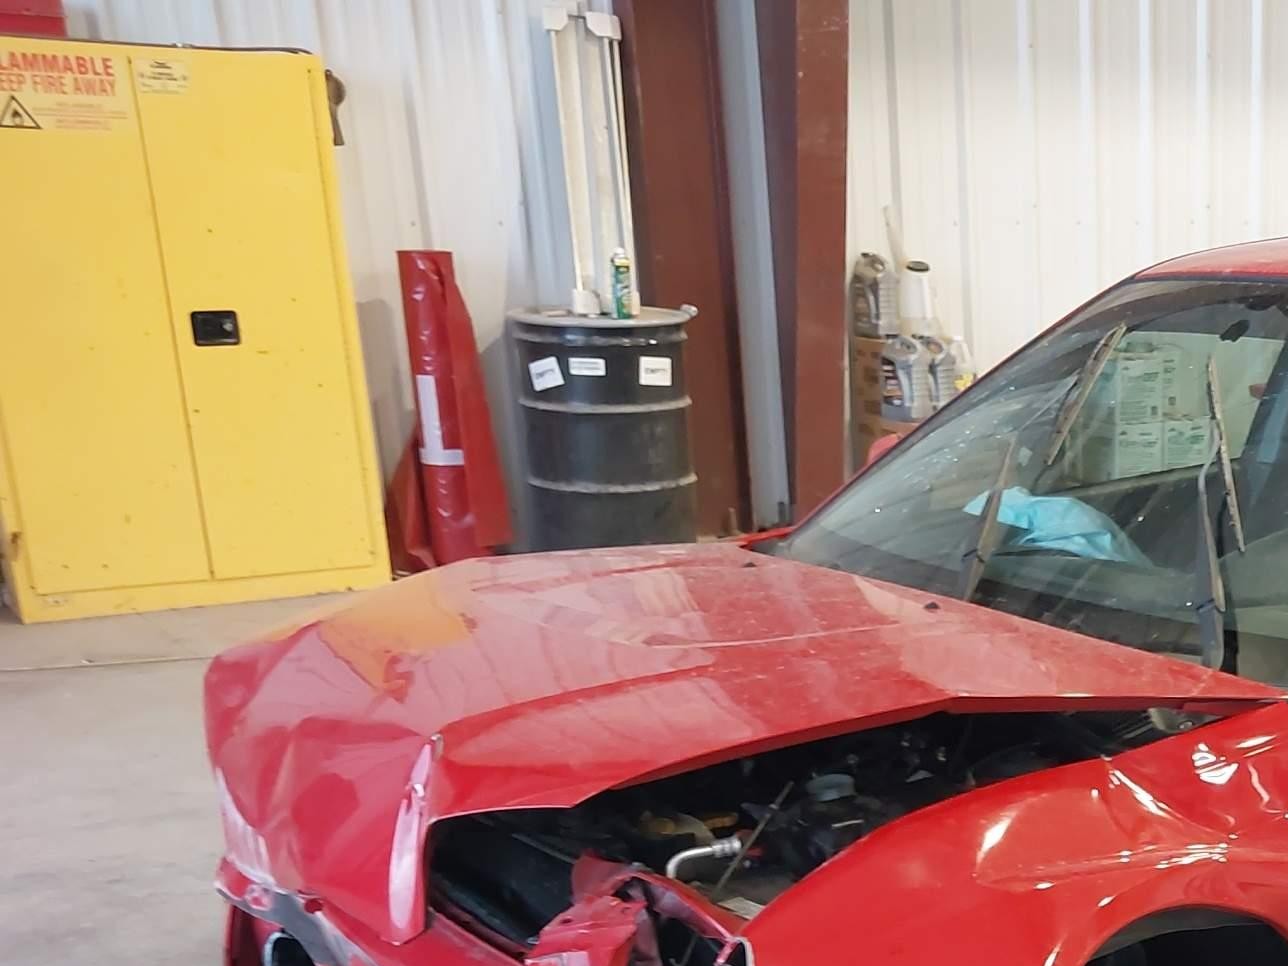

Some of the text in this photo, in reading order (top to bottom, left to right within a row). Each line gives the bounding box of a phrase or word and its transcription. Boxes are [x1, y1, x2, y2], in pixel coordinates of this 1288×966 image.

[0, 51, 115, 77] LAMMABLE
[0, 73, 117, 97] EEP FIRE AWAY
